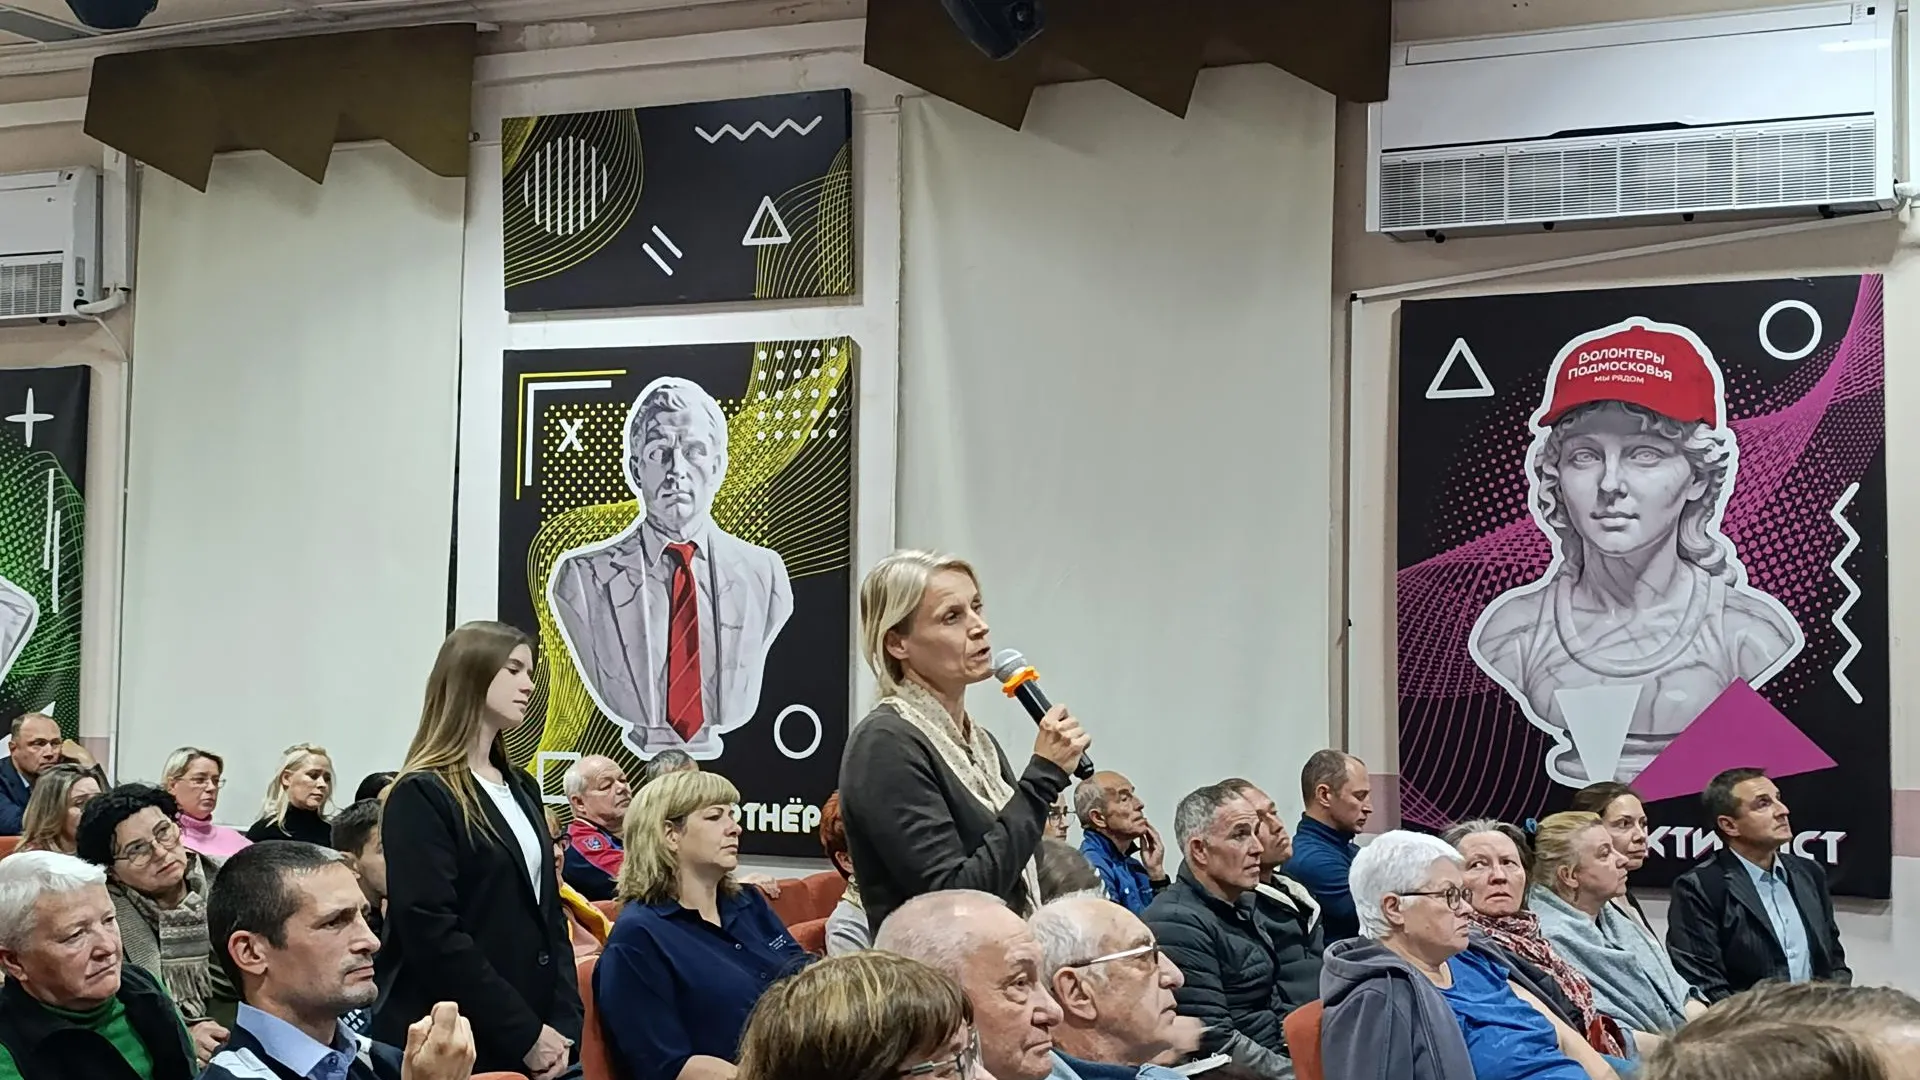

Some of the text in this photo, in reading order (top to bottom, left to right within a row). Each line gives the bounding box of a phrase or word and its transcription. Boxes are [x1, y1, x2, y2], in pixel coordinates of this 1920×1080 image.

[1578, 347, 1665, 365] ВОЛОНТЕРЫ
[1568, 361, 1673, 382] ПОДМОСКОВЬЯ
[1594, 374, 1645, 384] МЫ РЯДОМ
